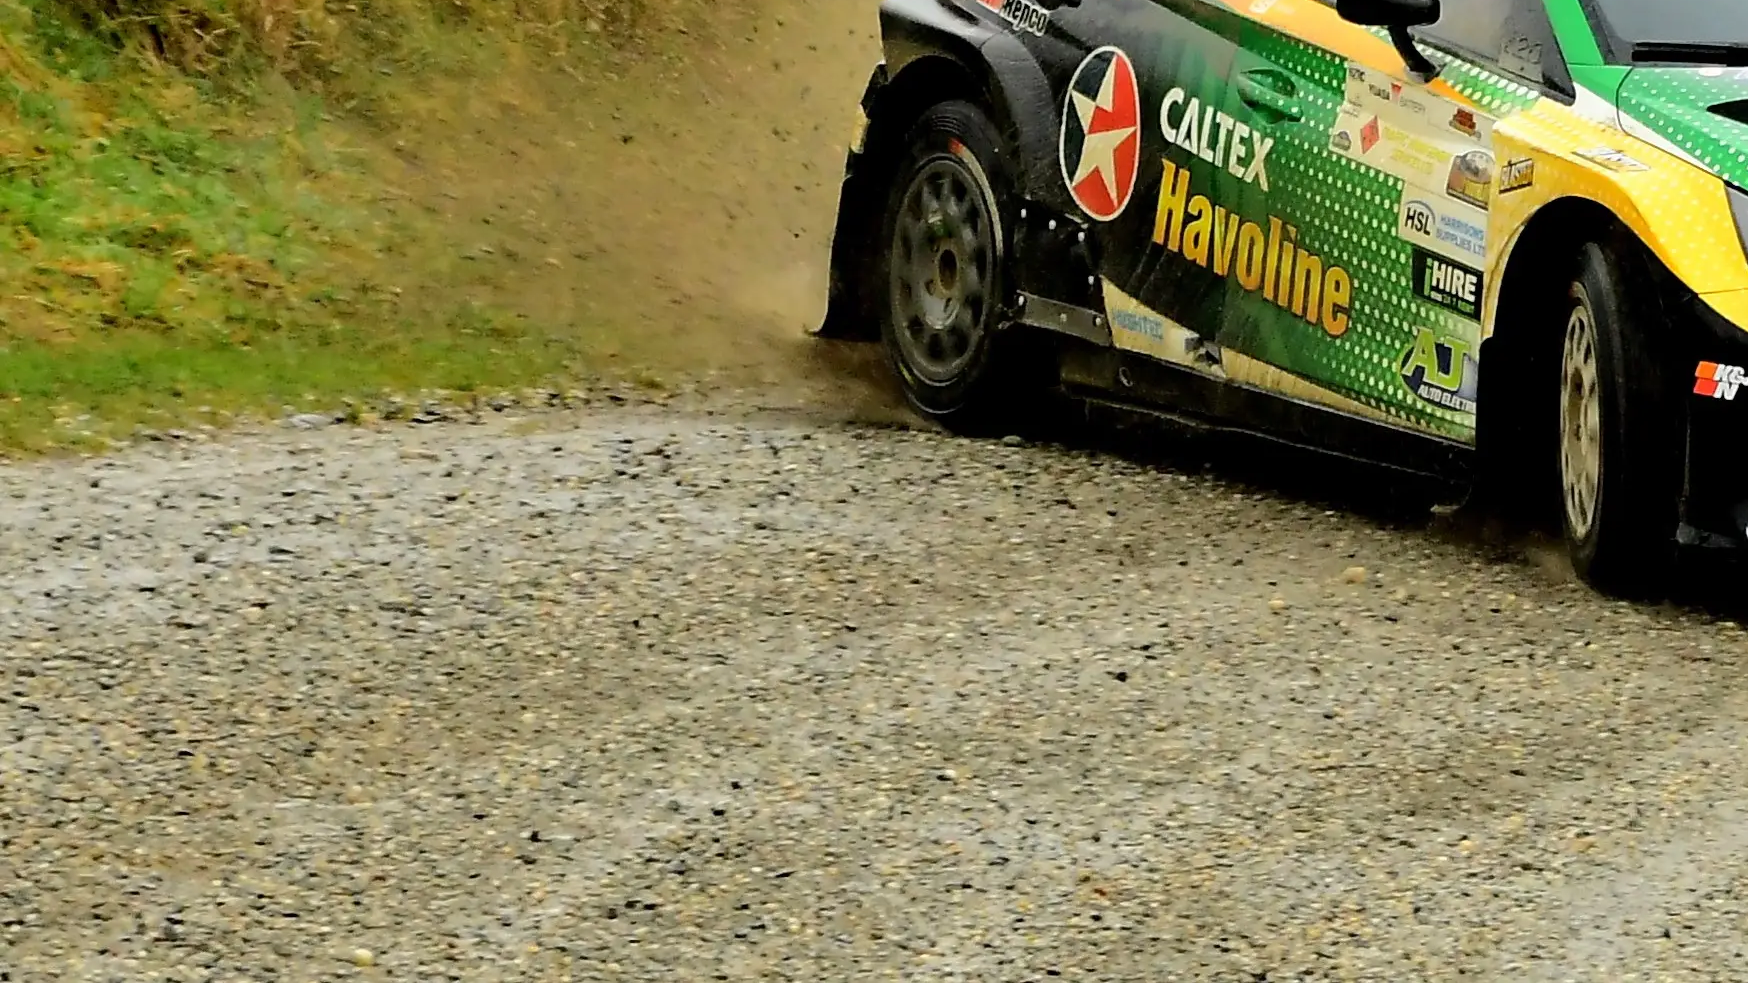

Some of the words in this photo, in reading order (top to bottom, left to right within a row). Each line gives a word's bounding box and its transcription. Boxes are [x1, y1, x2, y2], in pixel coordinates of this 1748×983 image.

[1160, 87, 1274, 192] CALTEX
[1152, 158, 1351, 337] Havoline
[1404, 207, 1432, 236] HSL
[1400, 326, 1471, 391] AJ
[1418, 384, 1442, 403] AUTO
